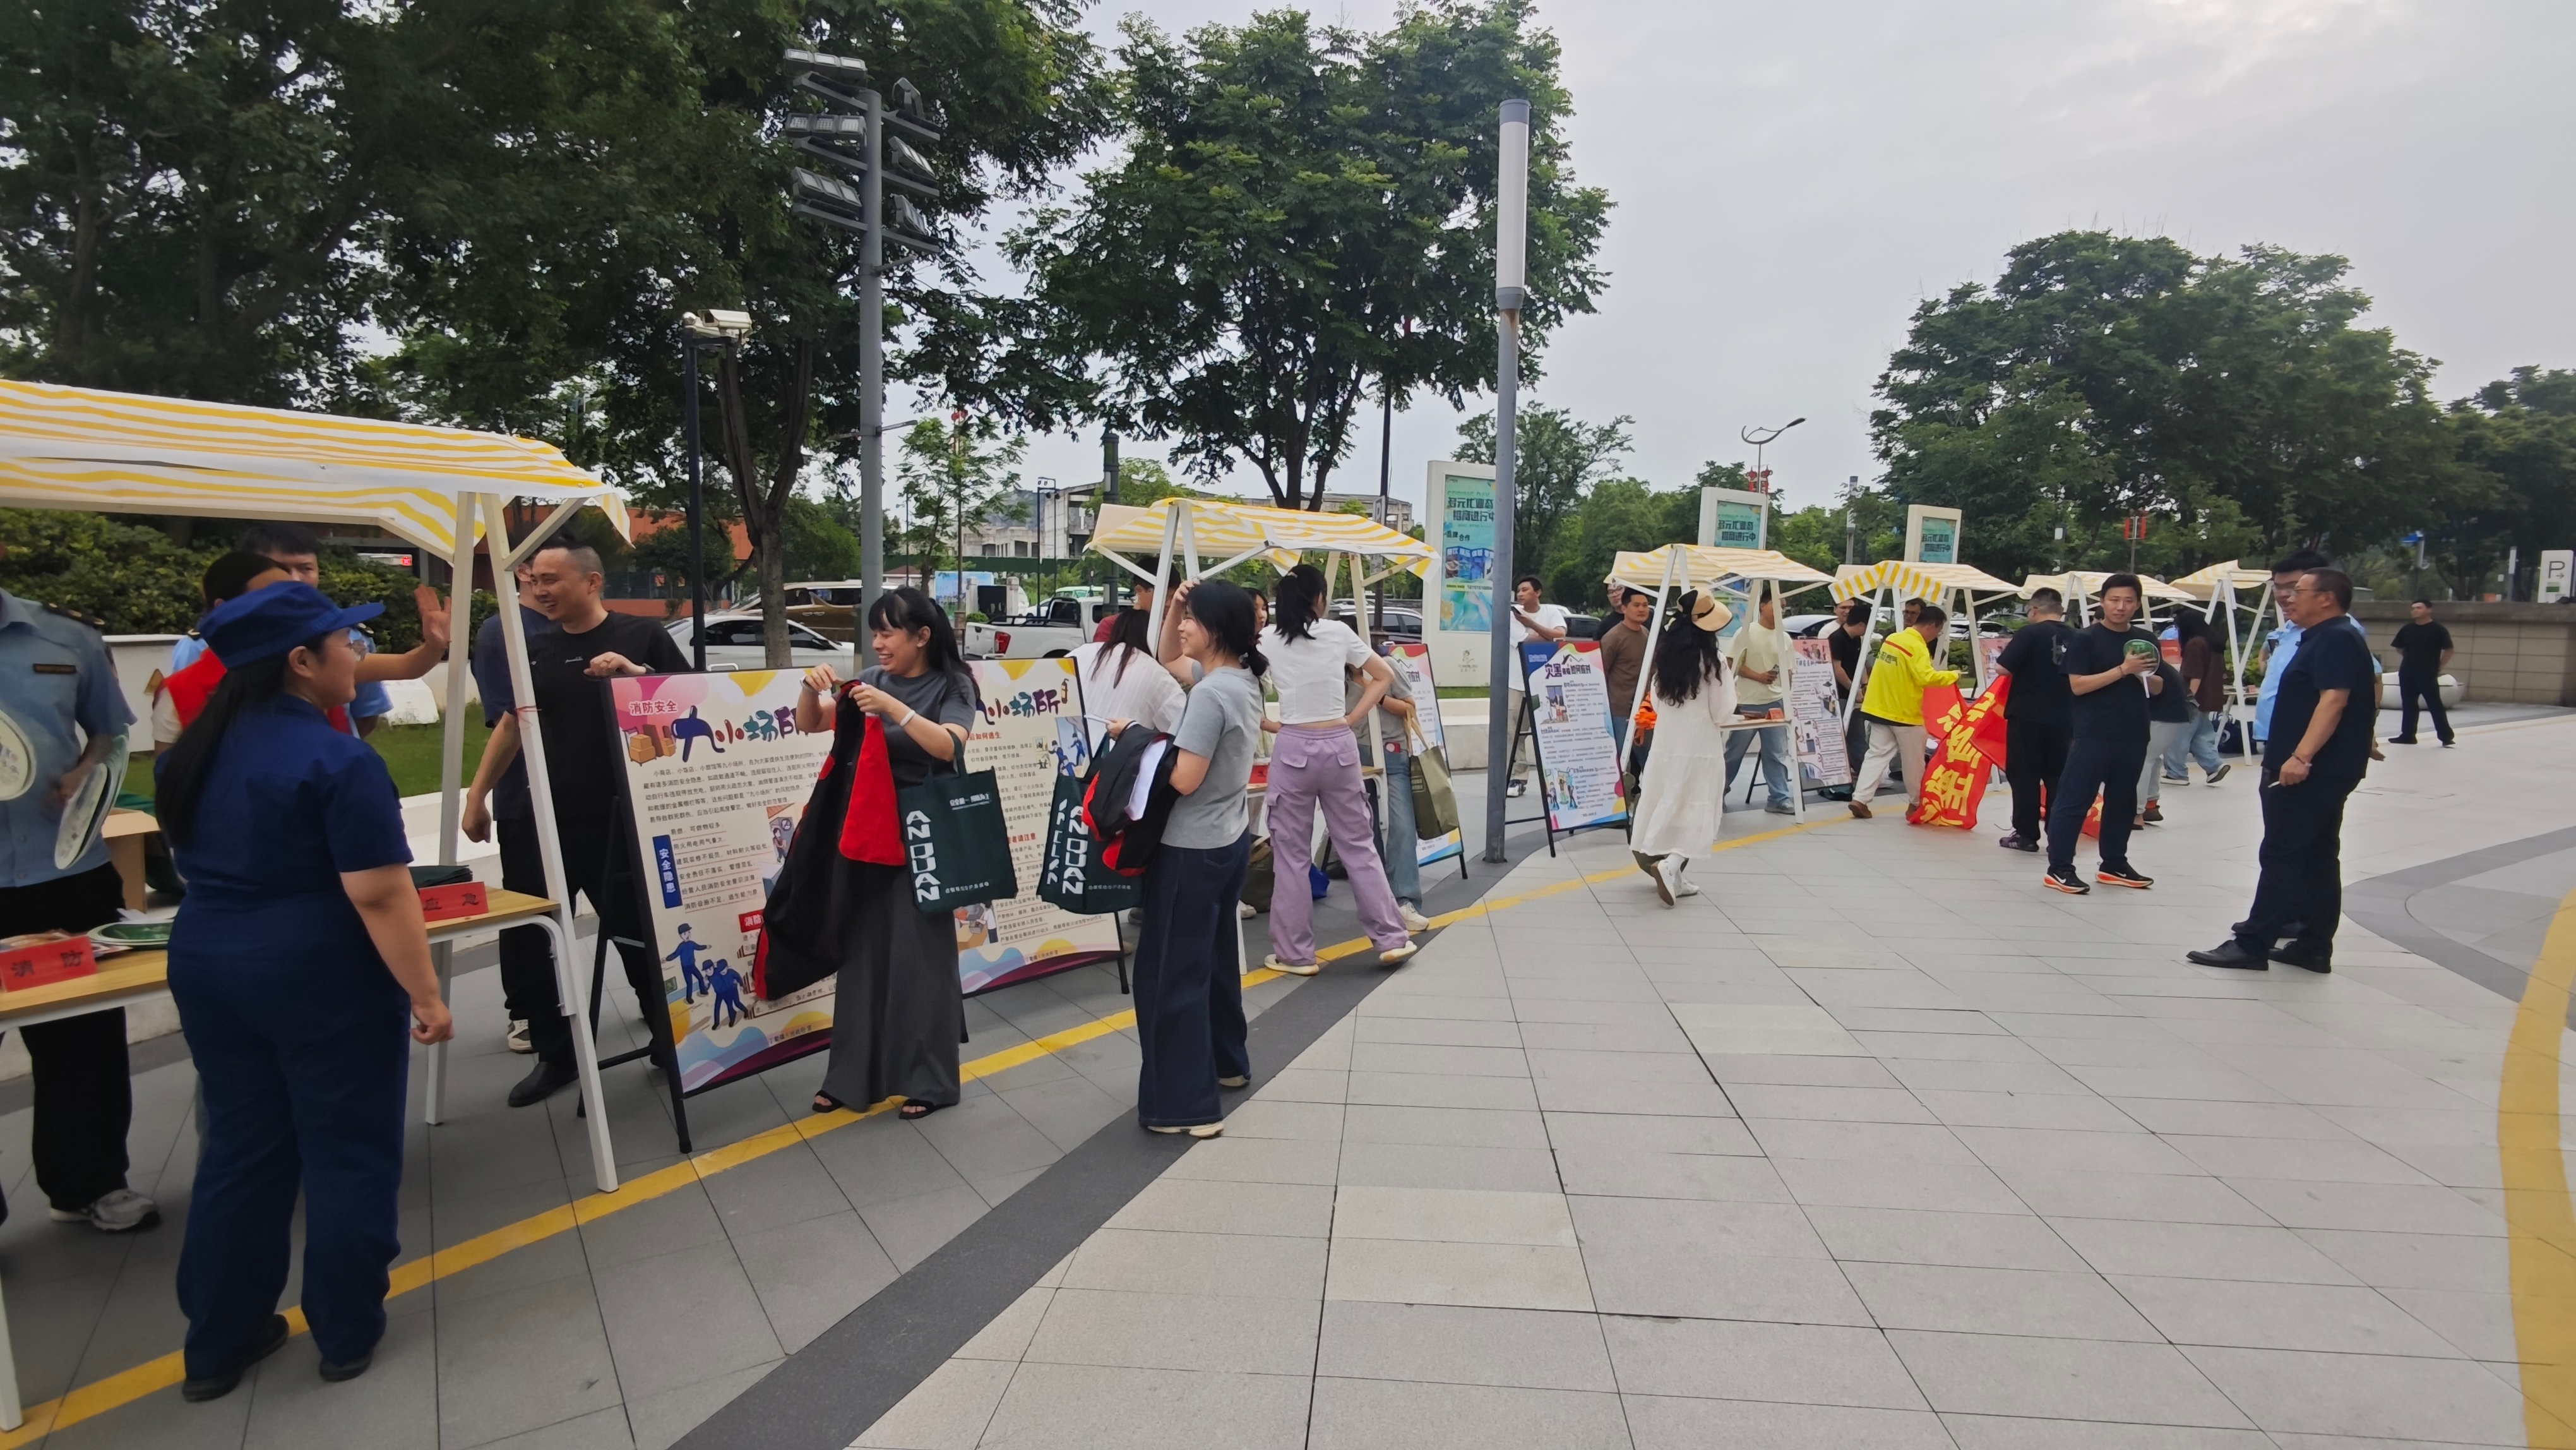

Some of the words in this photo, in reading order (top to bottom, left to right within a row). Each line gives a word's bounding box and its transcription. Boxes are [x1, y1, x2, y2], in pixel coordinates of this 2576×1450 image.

[2548, 561, 2565, 578] P
[630, 700, 677, 714] 消防安全
[11, 949, 84, 978] 消防
